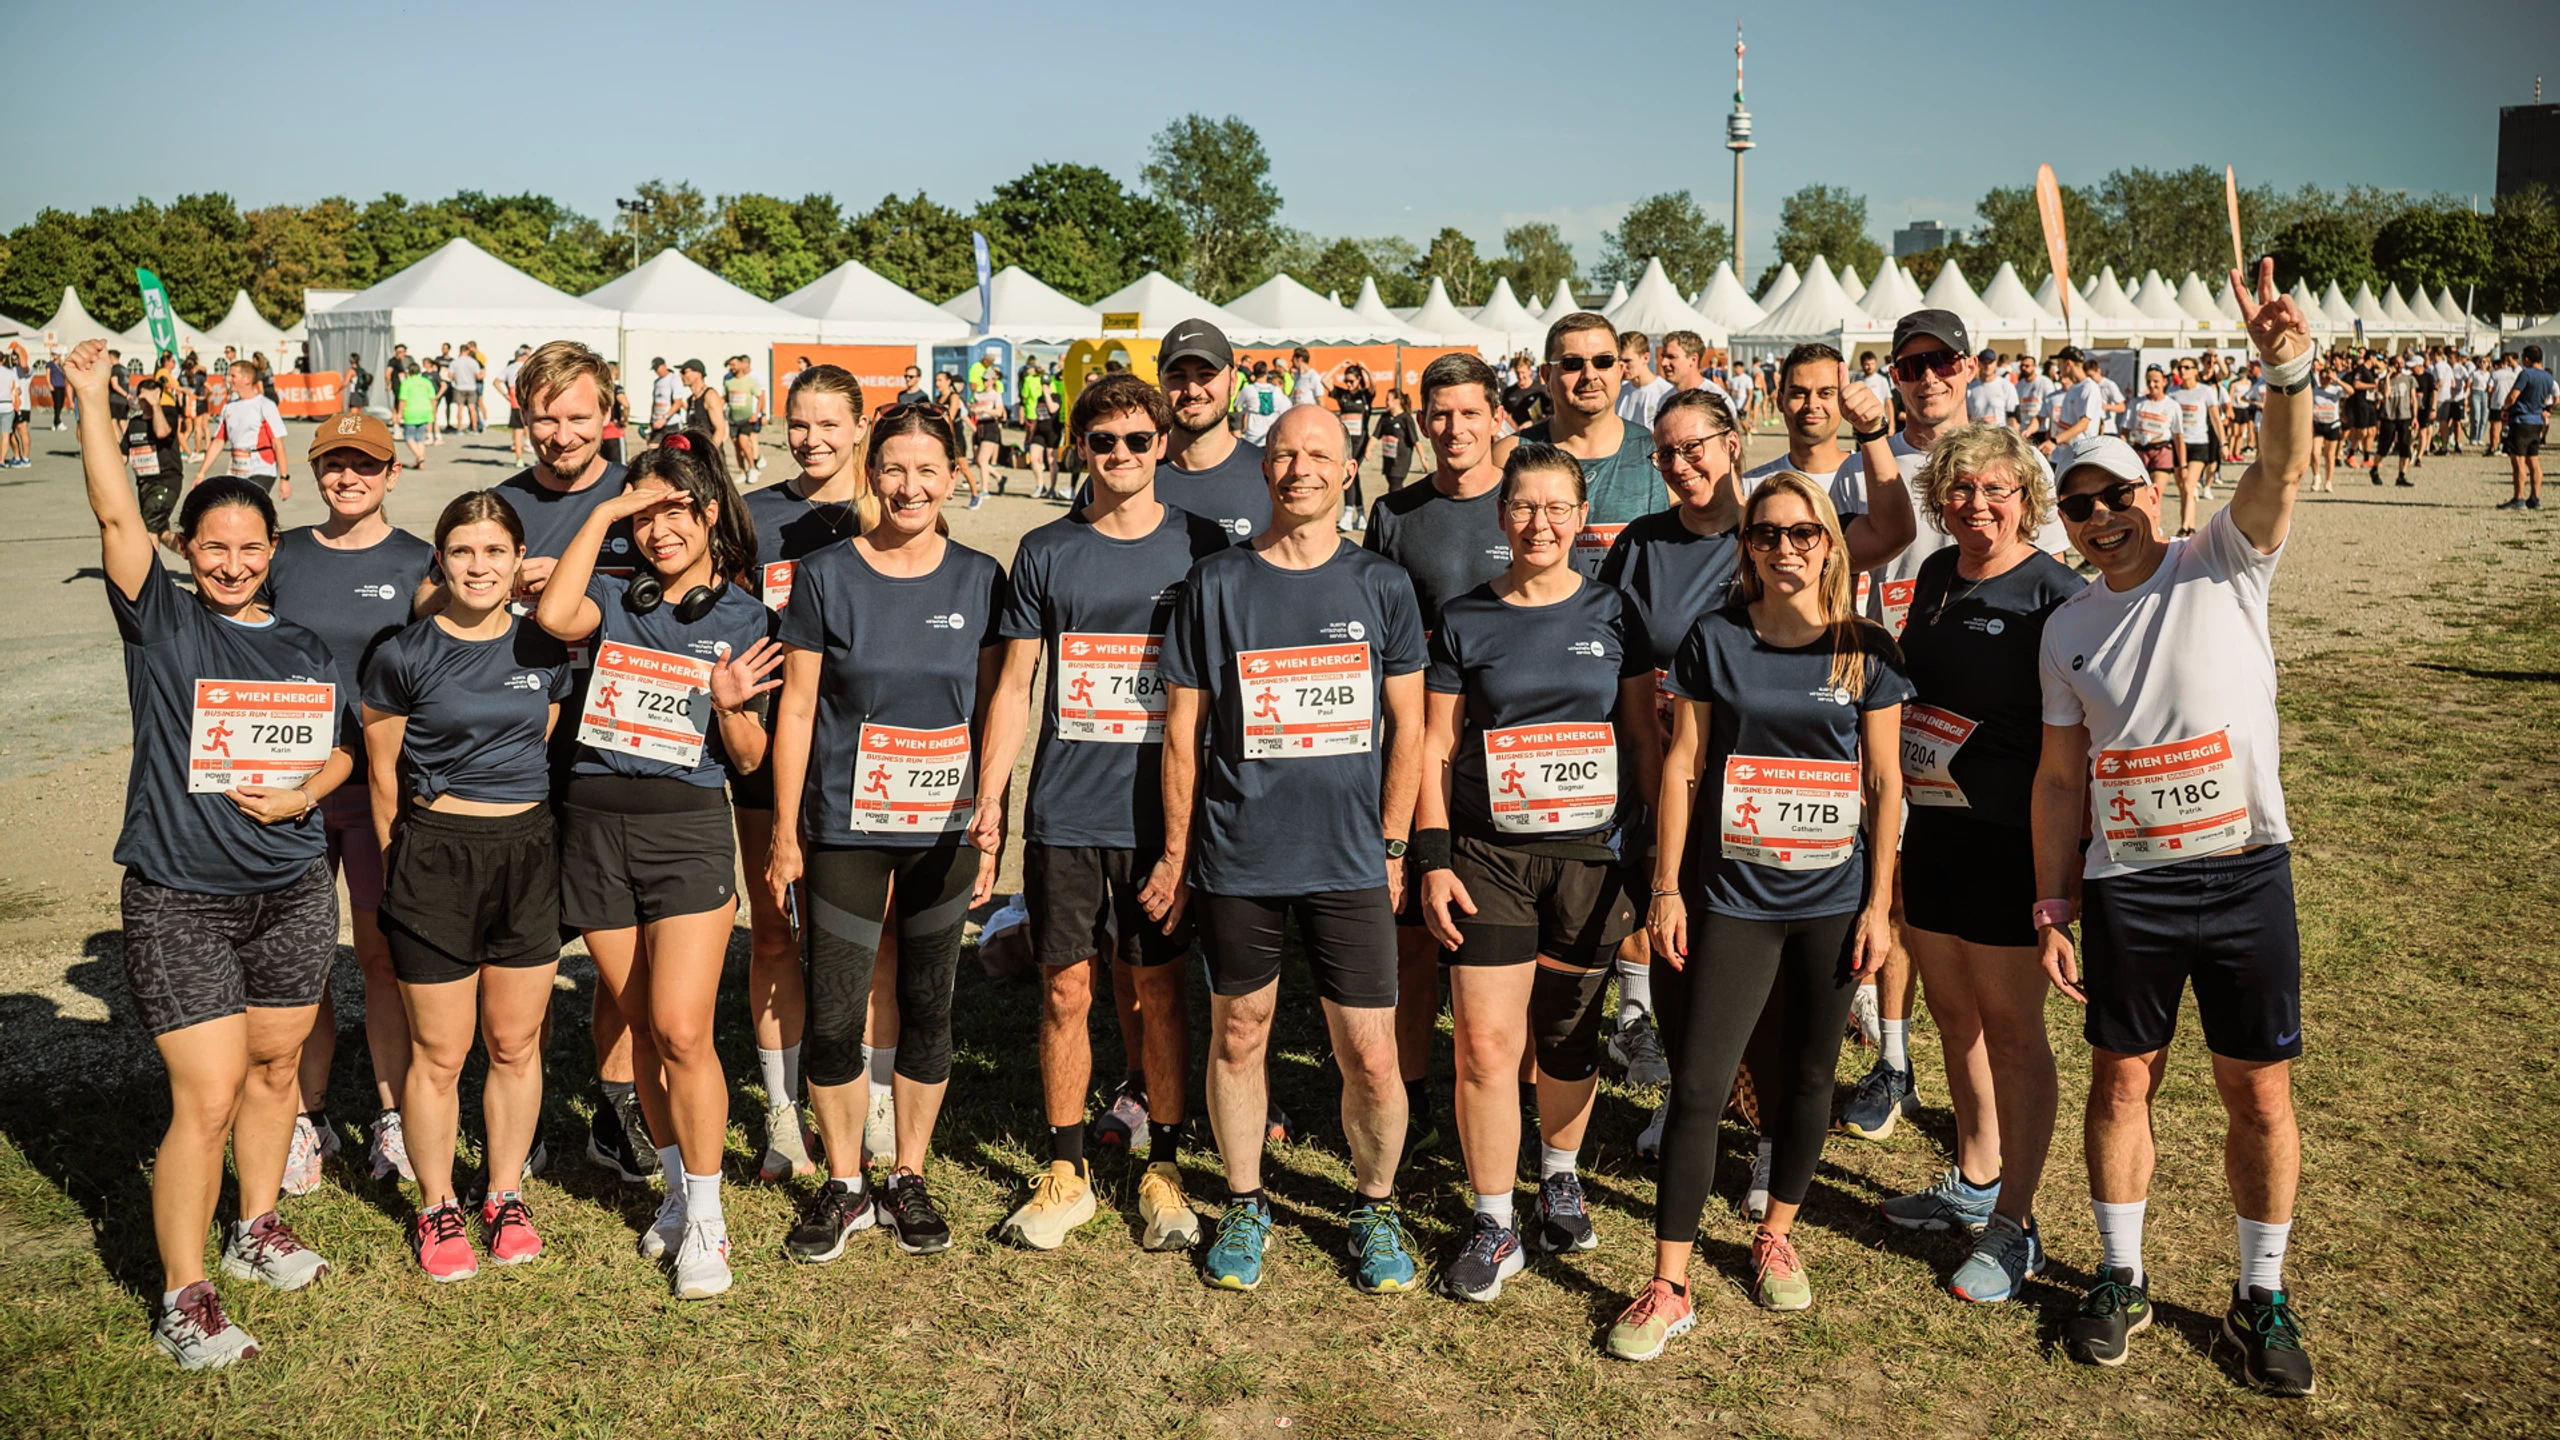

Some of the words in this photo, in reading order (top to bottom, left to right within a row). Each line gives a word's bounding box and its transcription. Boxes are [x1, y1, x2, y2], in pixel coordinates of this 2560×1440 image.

[278, 384, 335, 403] NERGIE
[1095, 644, 1127, 654] WIEN
[1129, 646, 1160, 655] ENER
[628, 656, 660, 670] WIEN
[1275, 657, 1308, 669] WIEN
[1311, 653, 1362, 667] ENERGIE
[600, 669, 636, 682] BUSINESS
[637, 676, 654, 685] RUN
[1250, 677, 1289, 686] BUSINESS
[1110, 676, 1167, 695] 718A
[235, 691, 270, 702] WIEN
[274, 692, 327, 704] ENERGIE
[638, 690, 692, 717] 722C
[1295, 685, 1355, 707] 724B
[204, 710, 246, 718] BUSINESS
[251, 724, 313, 744] 720B
[1927, 716, 1966, 737] ENERGIE
[894, 738, 926, 749] WIEN
[928, 735, 966, 749] ENERGIE
[1521, 733, 1553, 744] WIEN
[1556, 731, 1606, 741] ENERGIE
[270, 746, 292, 754] Karin
[1495, 752, 1534, 761] BUSINESS
[1904, 740, 1936, 769] 720A
[2124, 756, 2162, 770] WIEN
[2165, 742, 2223, 765] ENERGIE
[866, 753, 904, 763] BUSINESS
[908, 768, 960, 788] 722B
[1540, 761, 1598, 783] 720C
[1762, 768, 1795, 779] WIEN
[1798, 770, 1852, 783] ENERGIE
[2102, 778, 2142, 788] BUSINESS
[2145, 775, 2163, 784] RUN
[2207, 763, 2224, 772] 2025
[1558, 784, 1585, 792] Dagmar
[1733, 786, 1773, 795] BUSINESS
[2151, 779, 2220, 810] 718C
[1778, 802, 1839, 824] 717B
[2178, 807, 2203, 816] Patrik
[1791, 825, 1823, 833] Catharin
